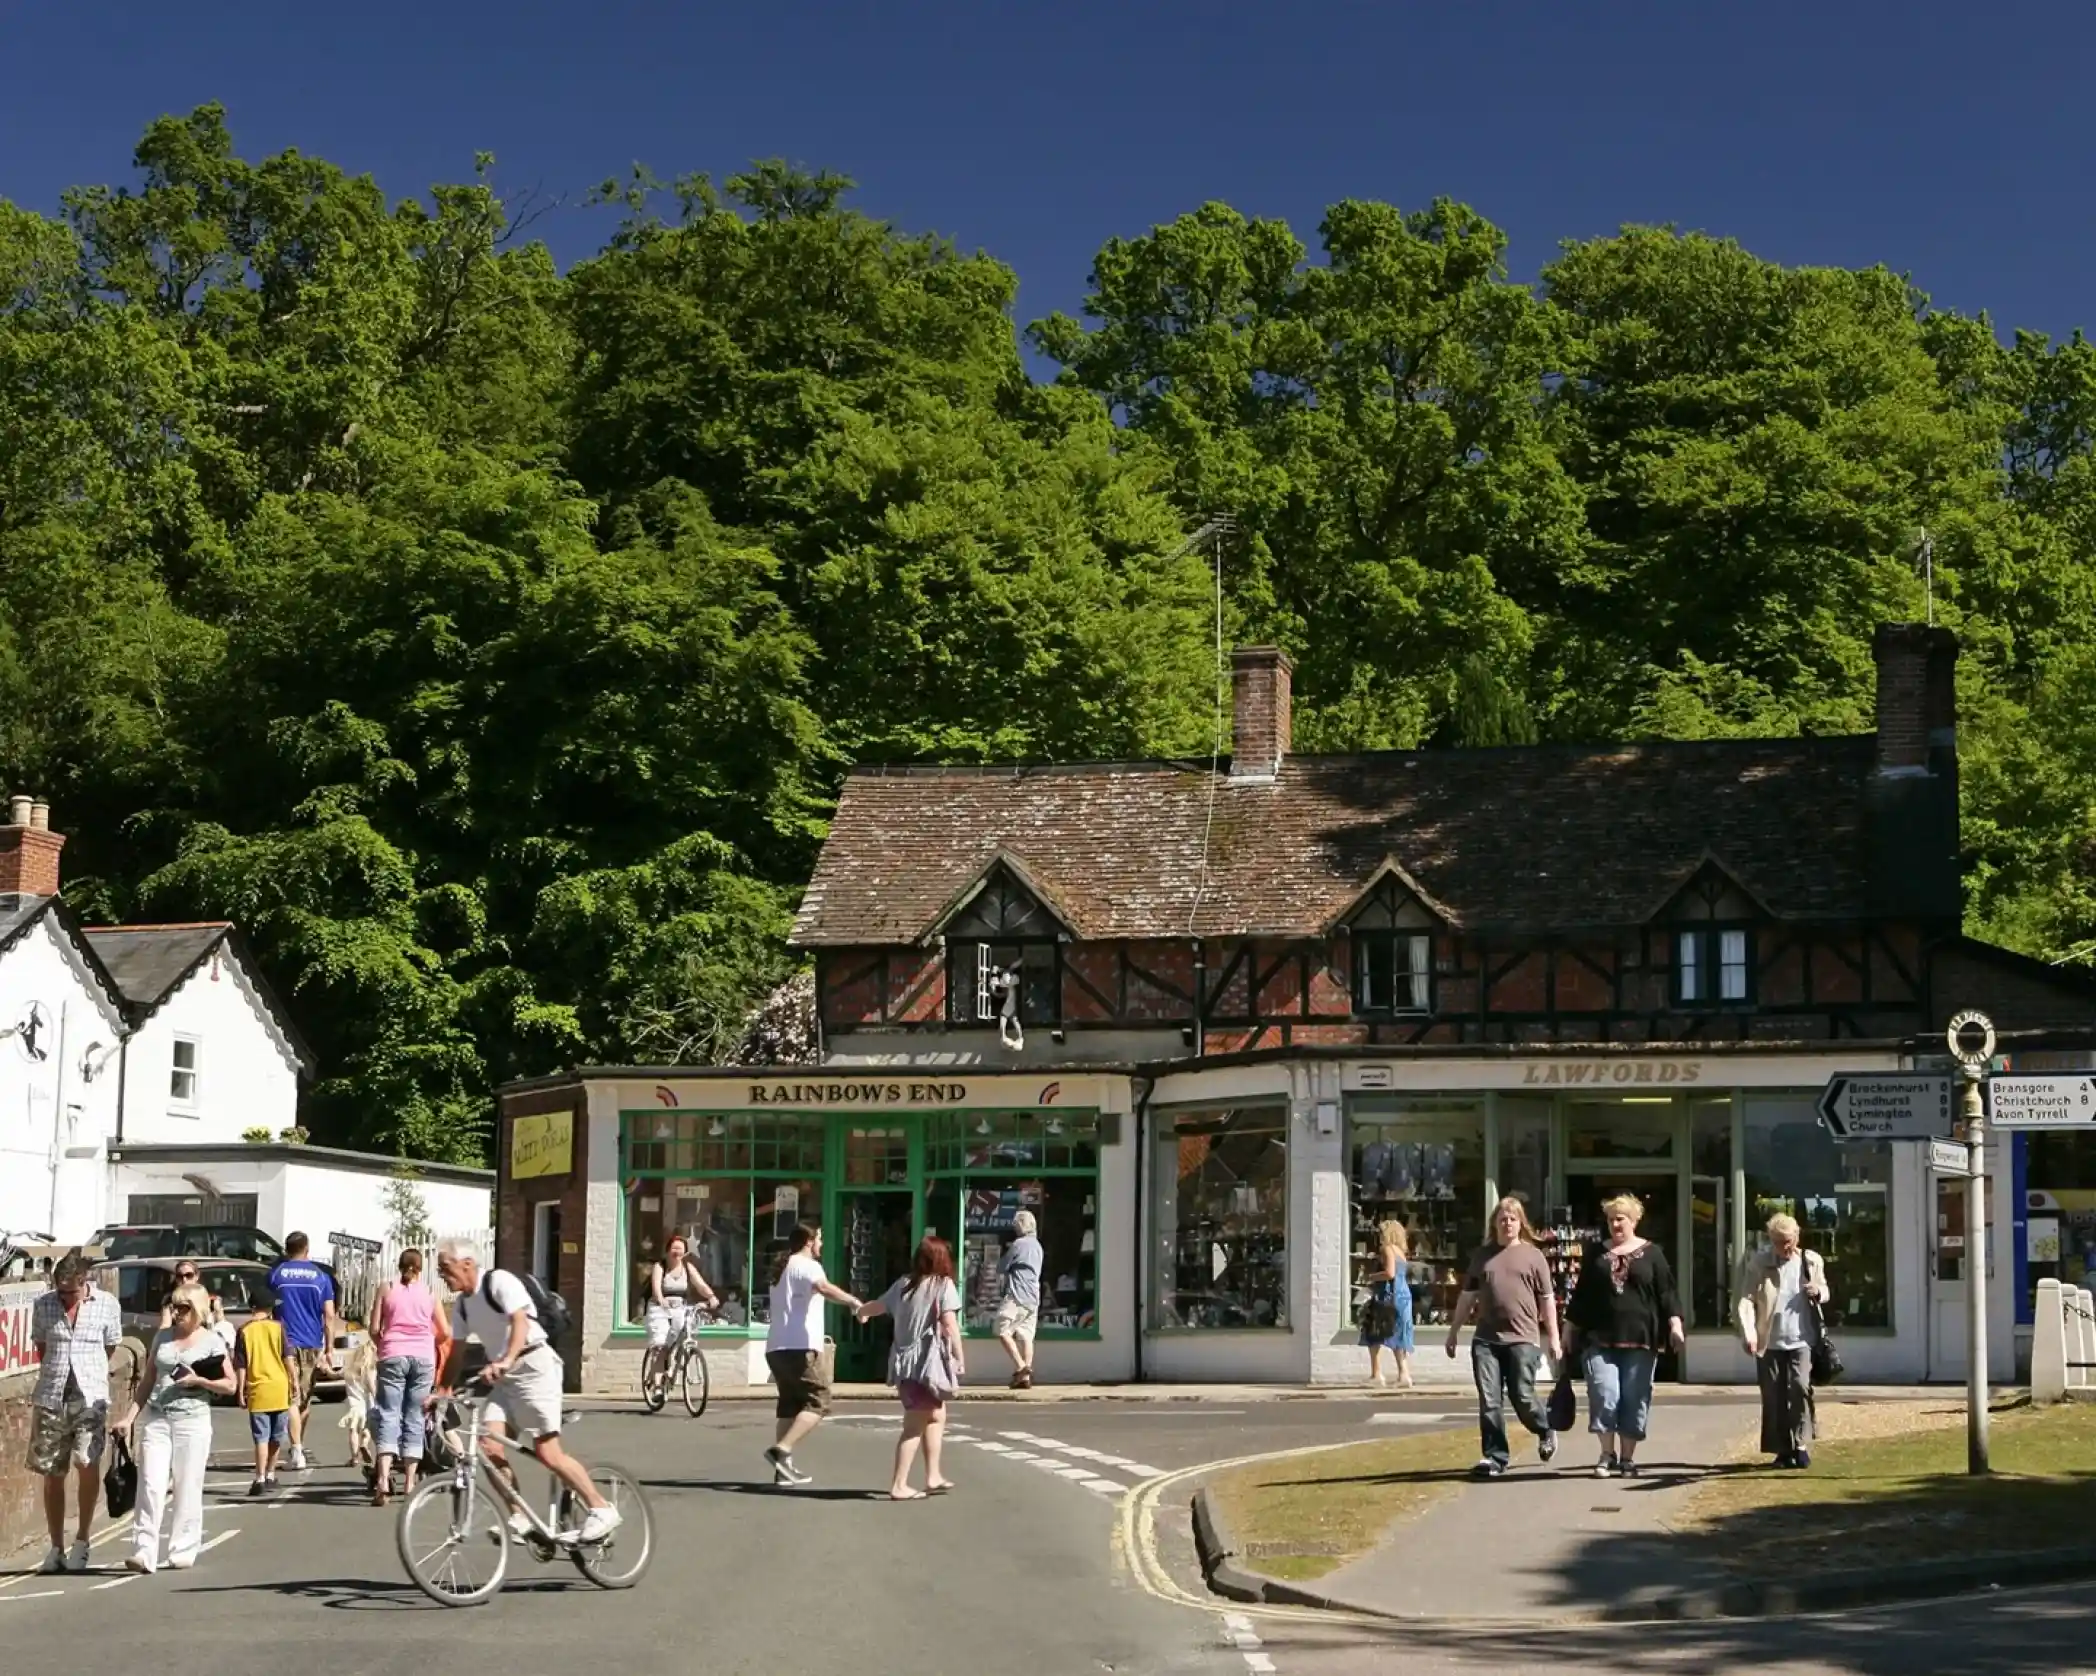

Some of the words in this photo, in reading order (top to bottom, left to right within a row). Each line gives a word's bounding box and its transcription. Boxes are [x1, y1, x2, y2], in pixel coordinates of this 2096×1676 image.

[1523, 1063, 1703, 1084] LAWFORDS
[748, 1084, 902, 1102] RAINBOWS
[907, 1083, 967, 1101] END
[1849, 1082, 1930, 1094] Brockenhurst
[1993, 1082, 2055, 1095] Bransgore
[2079, 1082, 2089, 1093] 4
[1849, 1095, 1911, 1108] Lyndhurst
[1994, 1095, 2072, 1106] Christchurch
[2080, 1094, 2089, 1106] 8
[1849, 1107, 1912, 1121] Lymington
[1995, 1108, 2024, 1119] Avon
[2028, 1108, 2069, 1120] Tyrrell
[1849, 1121, 1893, 1132] Church
